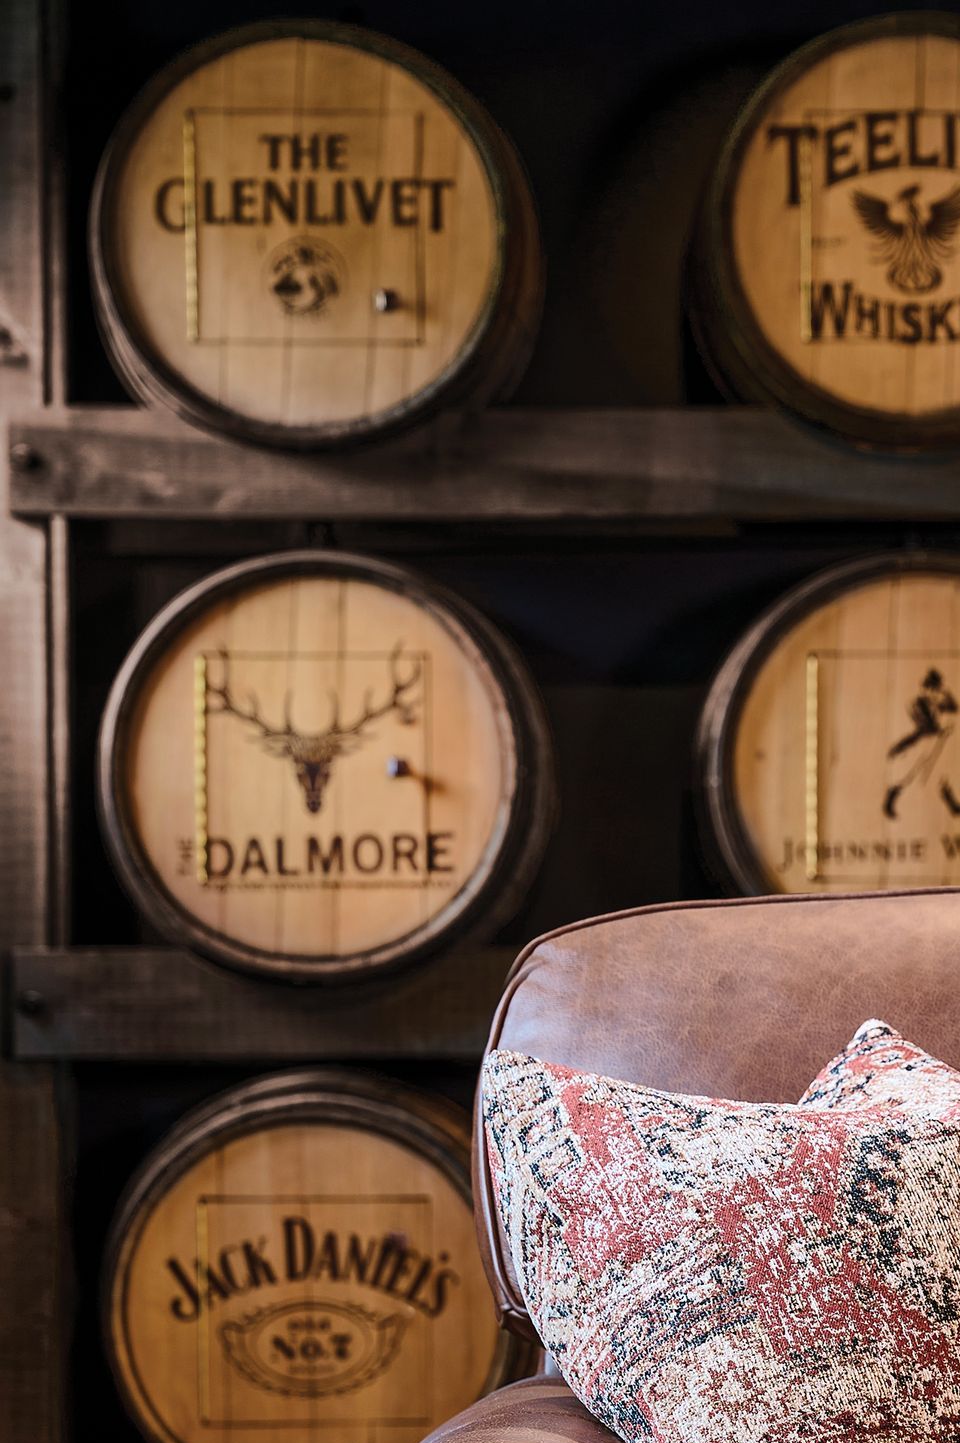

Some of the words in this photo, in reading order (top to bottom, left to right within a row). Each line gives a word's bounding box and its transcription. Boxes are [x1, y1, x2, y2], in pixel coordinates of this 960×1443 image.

[261, 132, 350, 172] THE
[153, 177, 454, 233] GLENLIVET
[205, 831, 455, 878] DALMORE
[166, 1236, 278, 1322] JACK
